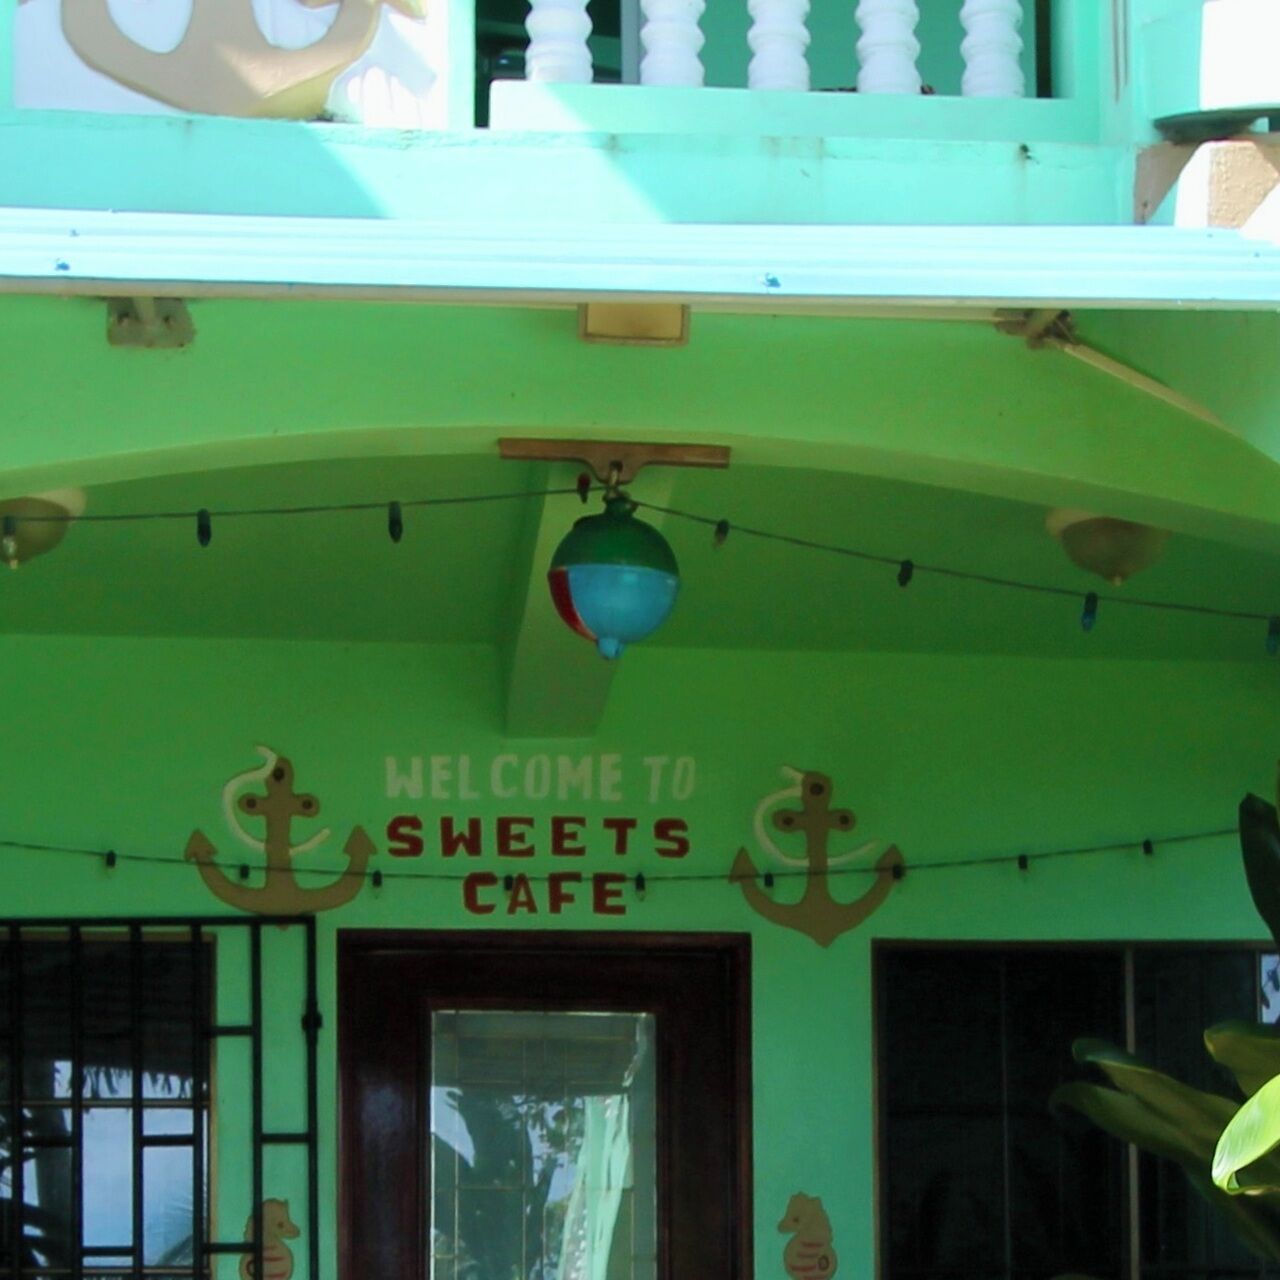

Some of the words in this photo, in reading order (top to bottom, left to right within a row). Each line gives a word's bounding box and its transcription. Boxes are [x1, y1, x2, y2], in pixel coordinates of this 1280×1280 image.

[384, 752, 623, 800] WELCOME
[643, 754, 697, 804] TO
[386, 814, 691, 859] SWEETS
[462, 871, 628, 916] CAFE
